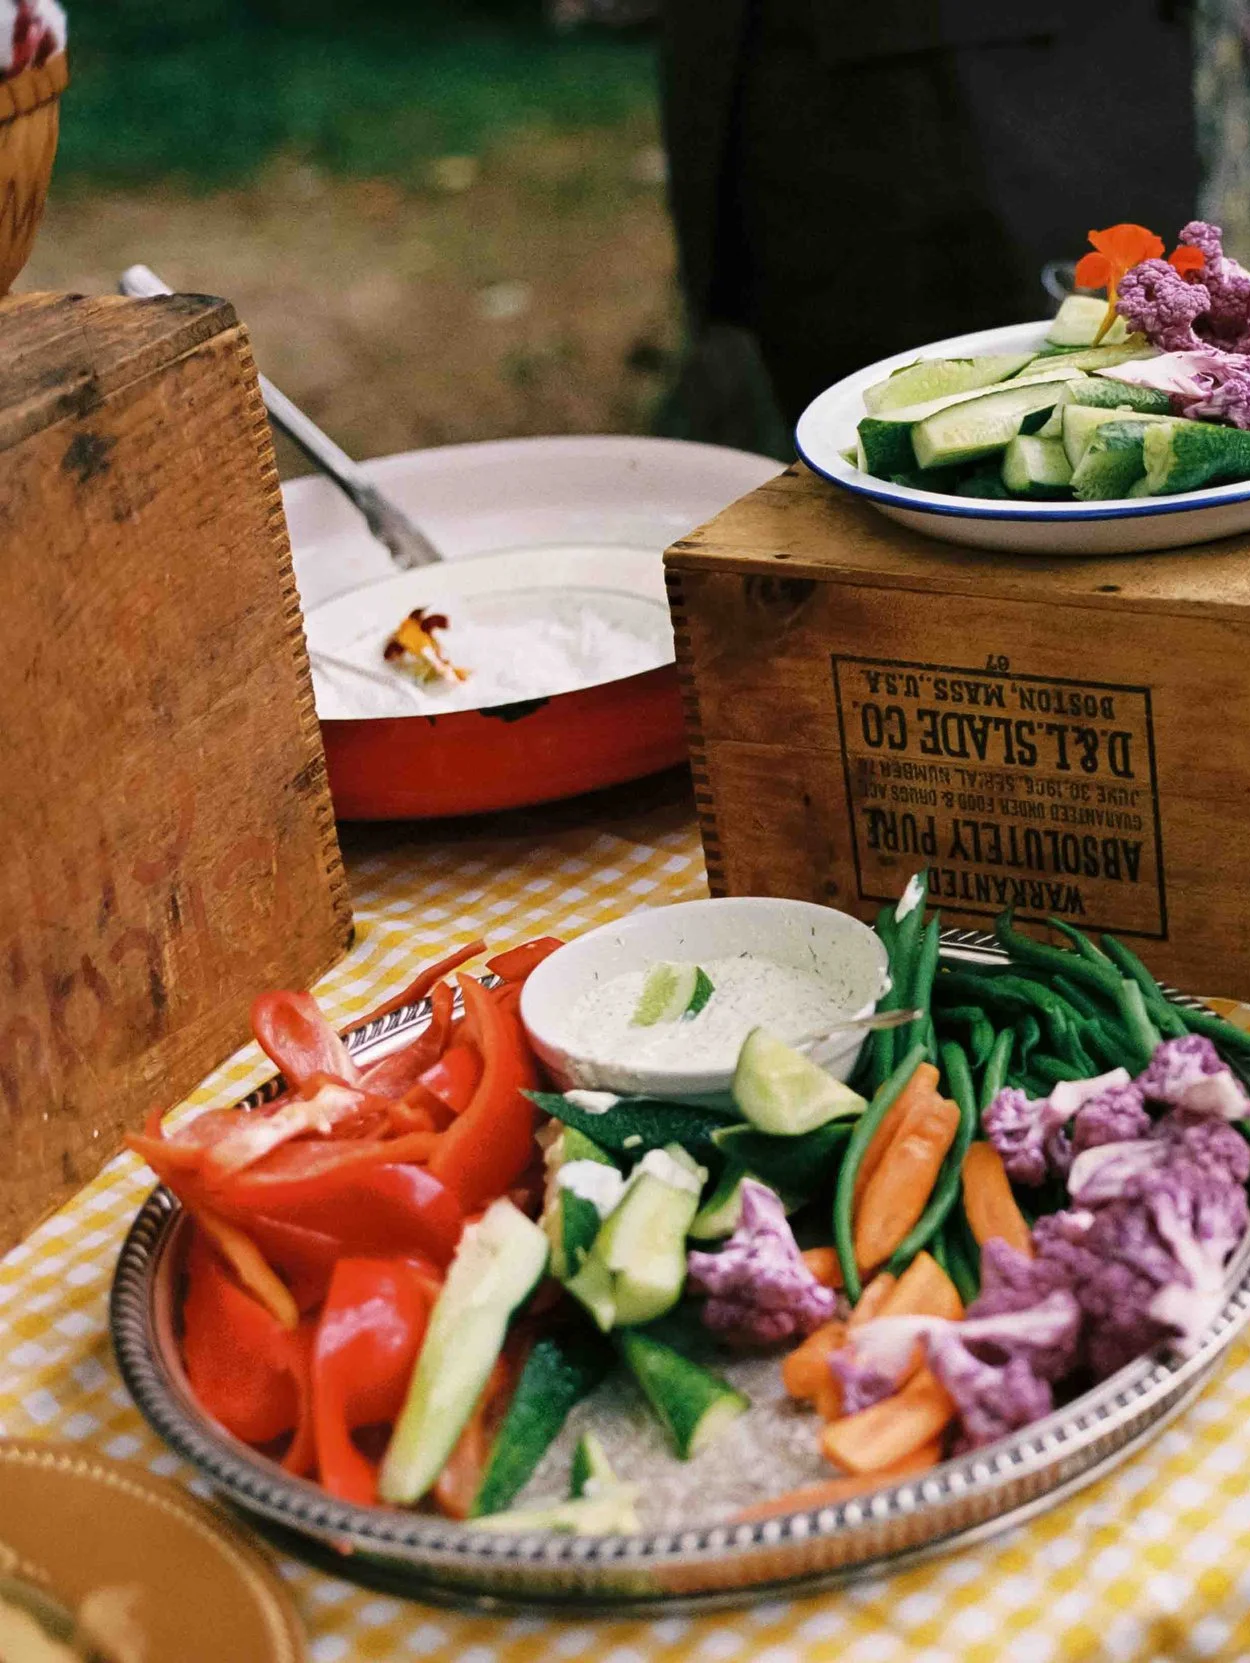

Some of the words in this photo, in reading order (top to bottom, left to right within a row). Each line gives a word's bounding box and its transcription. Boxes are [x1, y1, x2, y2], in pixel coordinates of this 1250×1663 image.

[852, 701, 907, 751] CO.
[879, 760, 949, 783] NUMBER
[891, 785, 937, 804] DRUGS
[941, 792, 953, 808] &
[957, 792, 994, 812] FOOD
[1001, 798, 1045, 819] UNDER
[1050, 803, 1142, 831] GUARANTEED
[862, 808, 937, 856] PURE
[947, 818, 1142, 882] ABSOLUTELY
[925, 866, 1085, 915] WARRANTED
